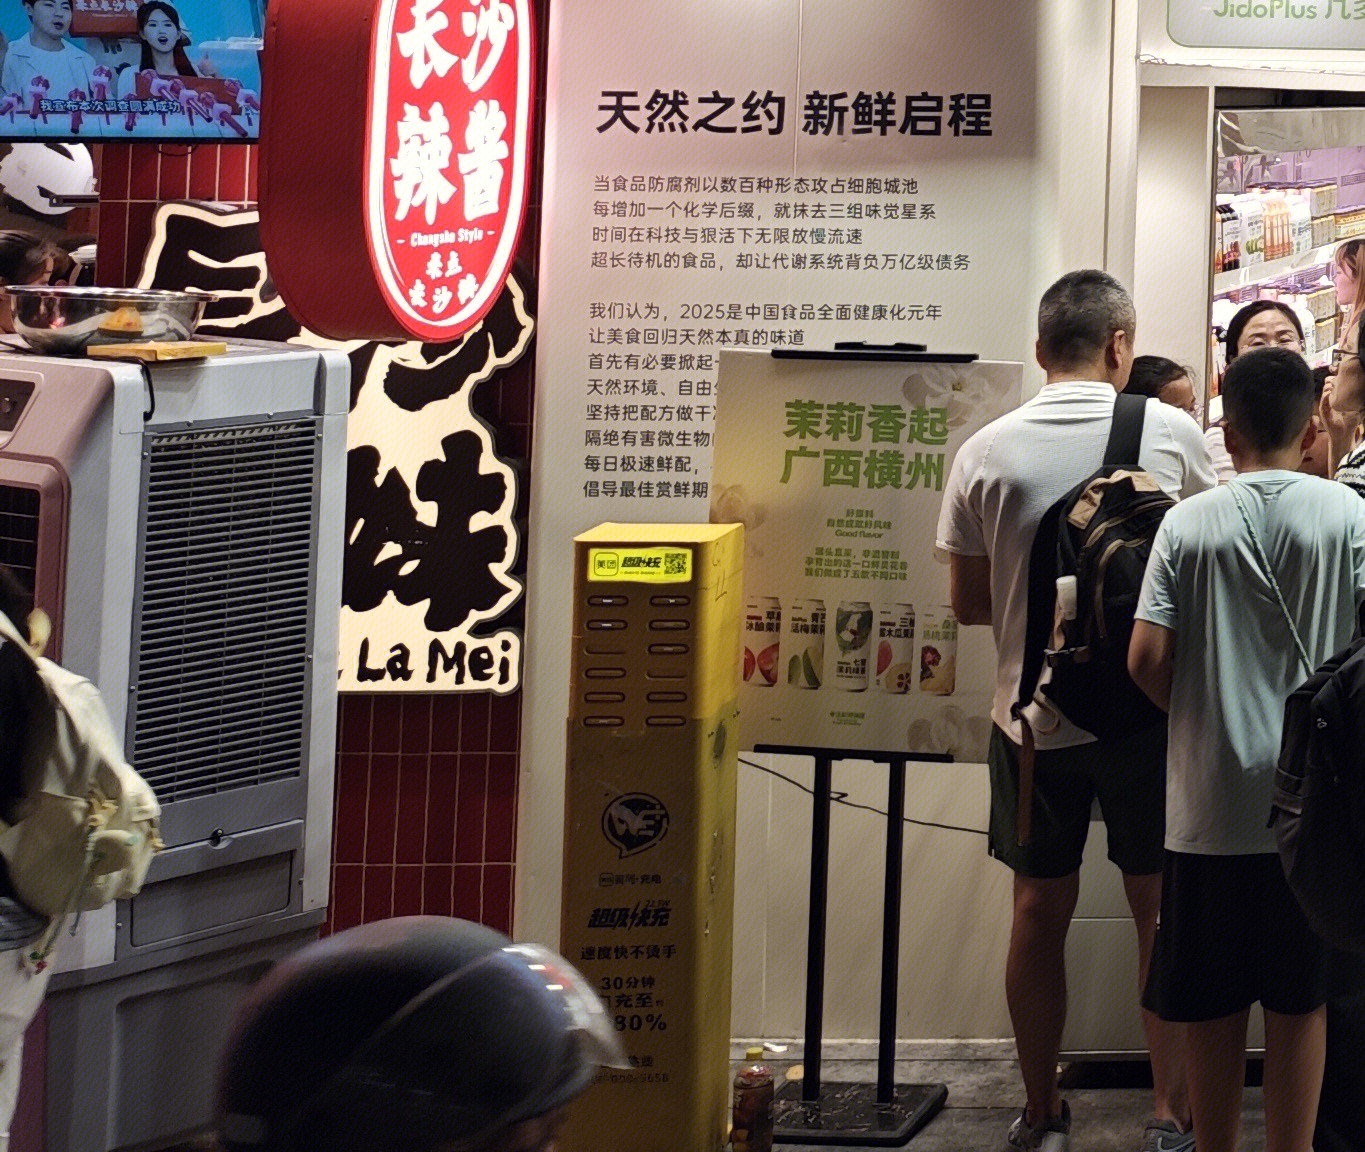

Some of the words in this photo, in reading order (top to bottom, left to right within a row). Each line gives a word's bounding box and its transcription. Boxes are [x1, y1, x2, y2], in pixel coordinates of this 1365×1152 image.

[596, 88, 787, 136] 天然之约
[802, 90, 994, 138] 新鲜启程
[389, 98, 509, 226] 辣酱
[592, 174, 920, 197] 当食品防腐剂以数百种形态攻占细胞城池
[591, 199, 938, 222] 每增加一个化学后缀，就抹去三组味觉星系
[591, 225, 864, 246] 时间在科技与狠活下无限放慢流速
[590, 251, 972, 273] 超长待机的食品，却让代谢系统背负万亿级债务
[588, 301, 943, 323] 我们认为，2025是中国食品全面健康化元年
[588, 327, 806, 347] 让美食回归天然本真的味道
[585, 403, 717, 423] 坚持把配方做干
[783, 397, 950, 447] 茉莉香起
[584, 429, 715, 449] 隔绝有害微生物
[779, 445, 947, 493] 广西横州
[582, 479, 709, 500] 倡导最佳赏鲜期
[356, 636, 415, 683] La
[425, 637, 512, 686] Mei
